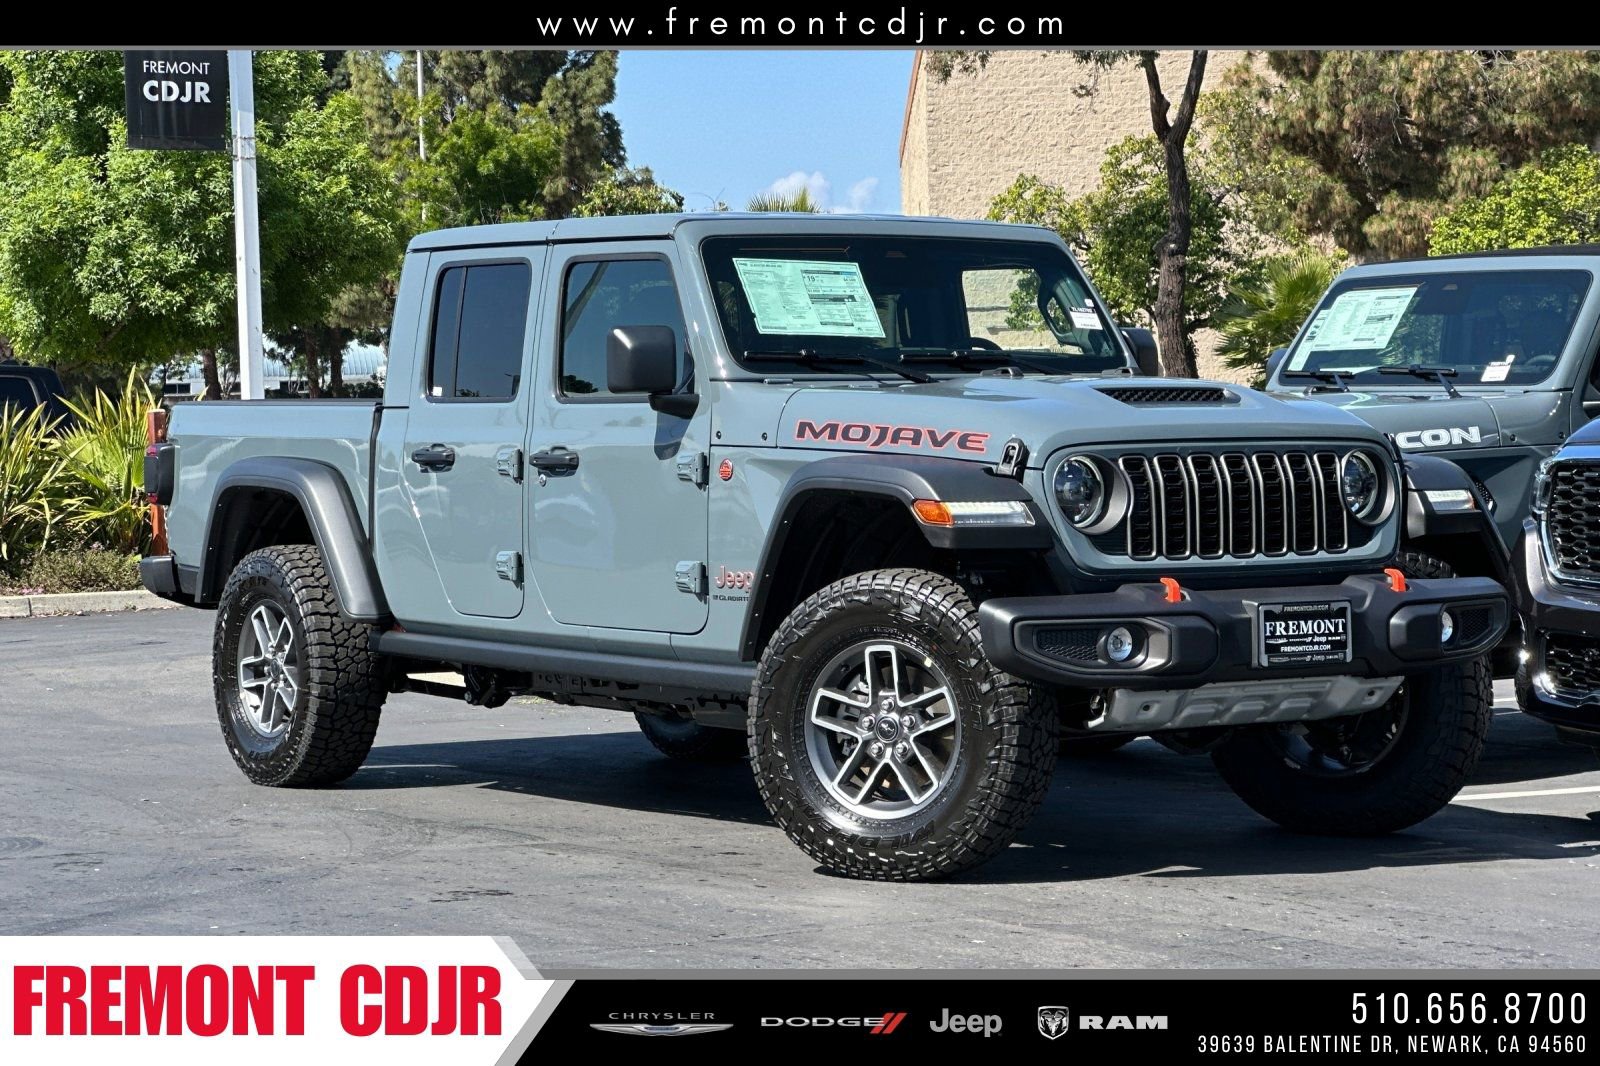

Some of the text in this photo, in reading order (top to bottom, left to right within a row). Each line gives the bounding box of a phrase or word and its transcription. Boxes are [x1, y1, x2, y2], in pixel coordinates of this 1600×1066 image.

[143, 60, 211, 75] FREMONT
[142, 80, 211, 103] CDJR
[795, 419, 990, 454] MOJAVE
[714, 565, 754, 593] Jeep
[1265, 619, 1345, 636] FREMONT
